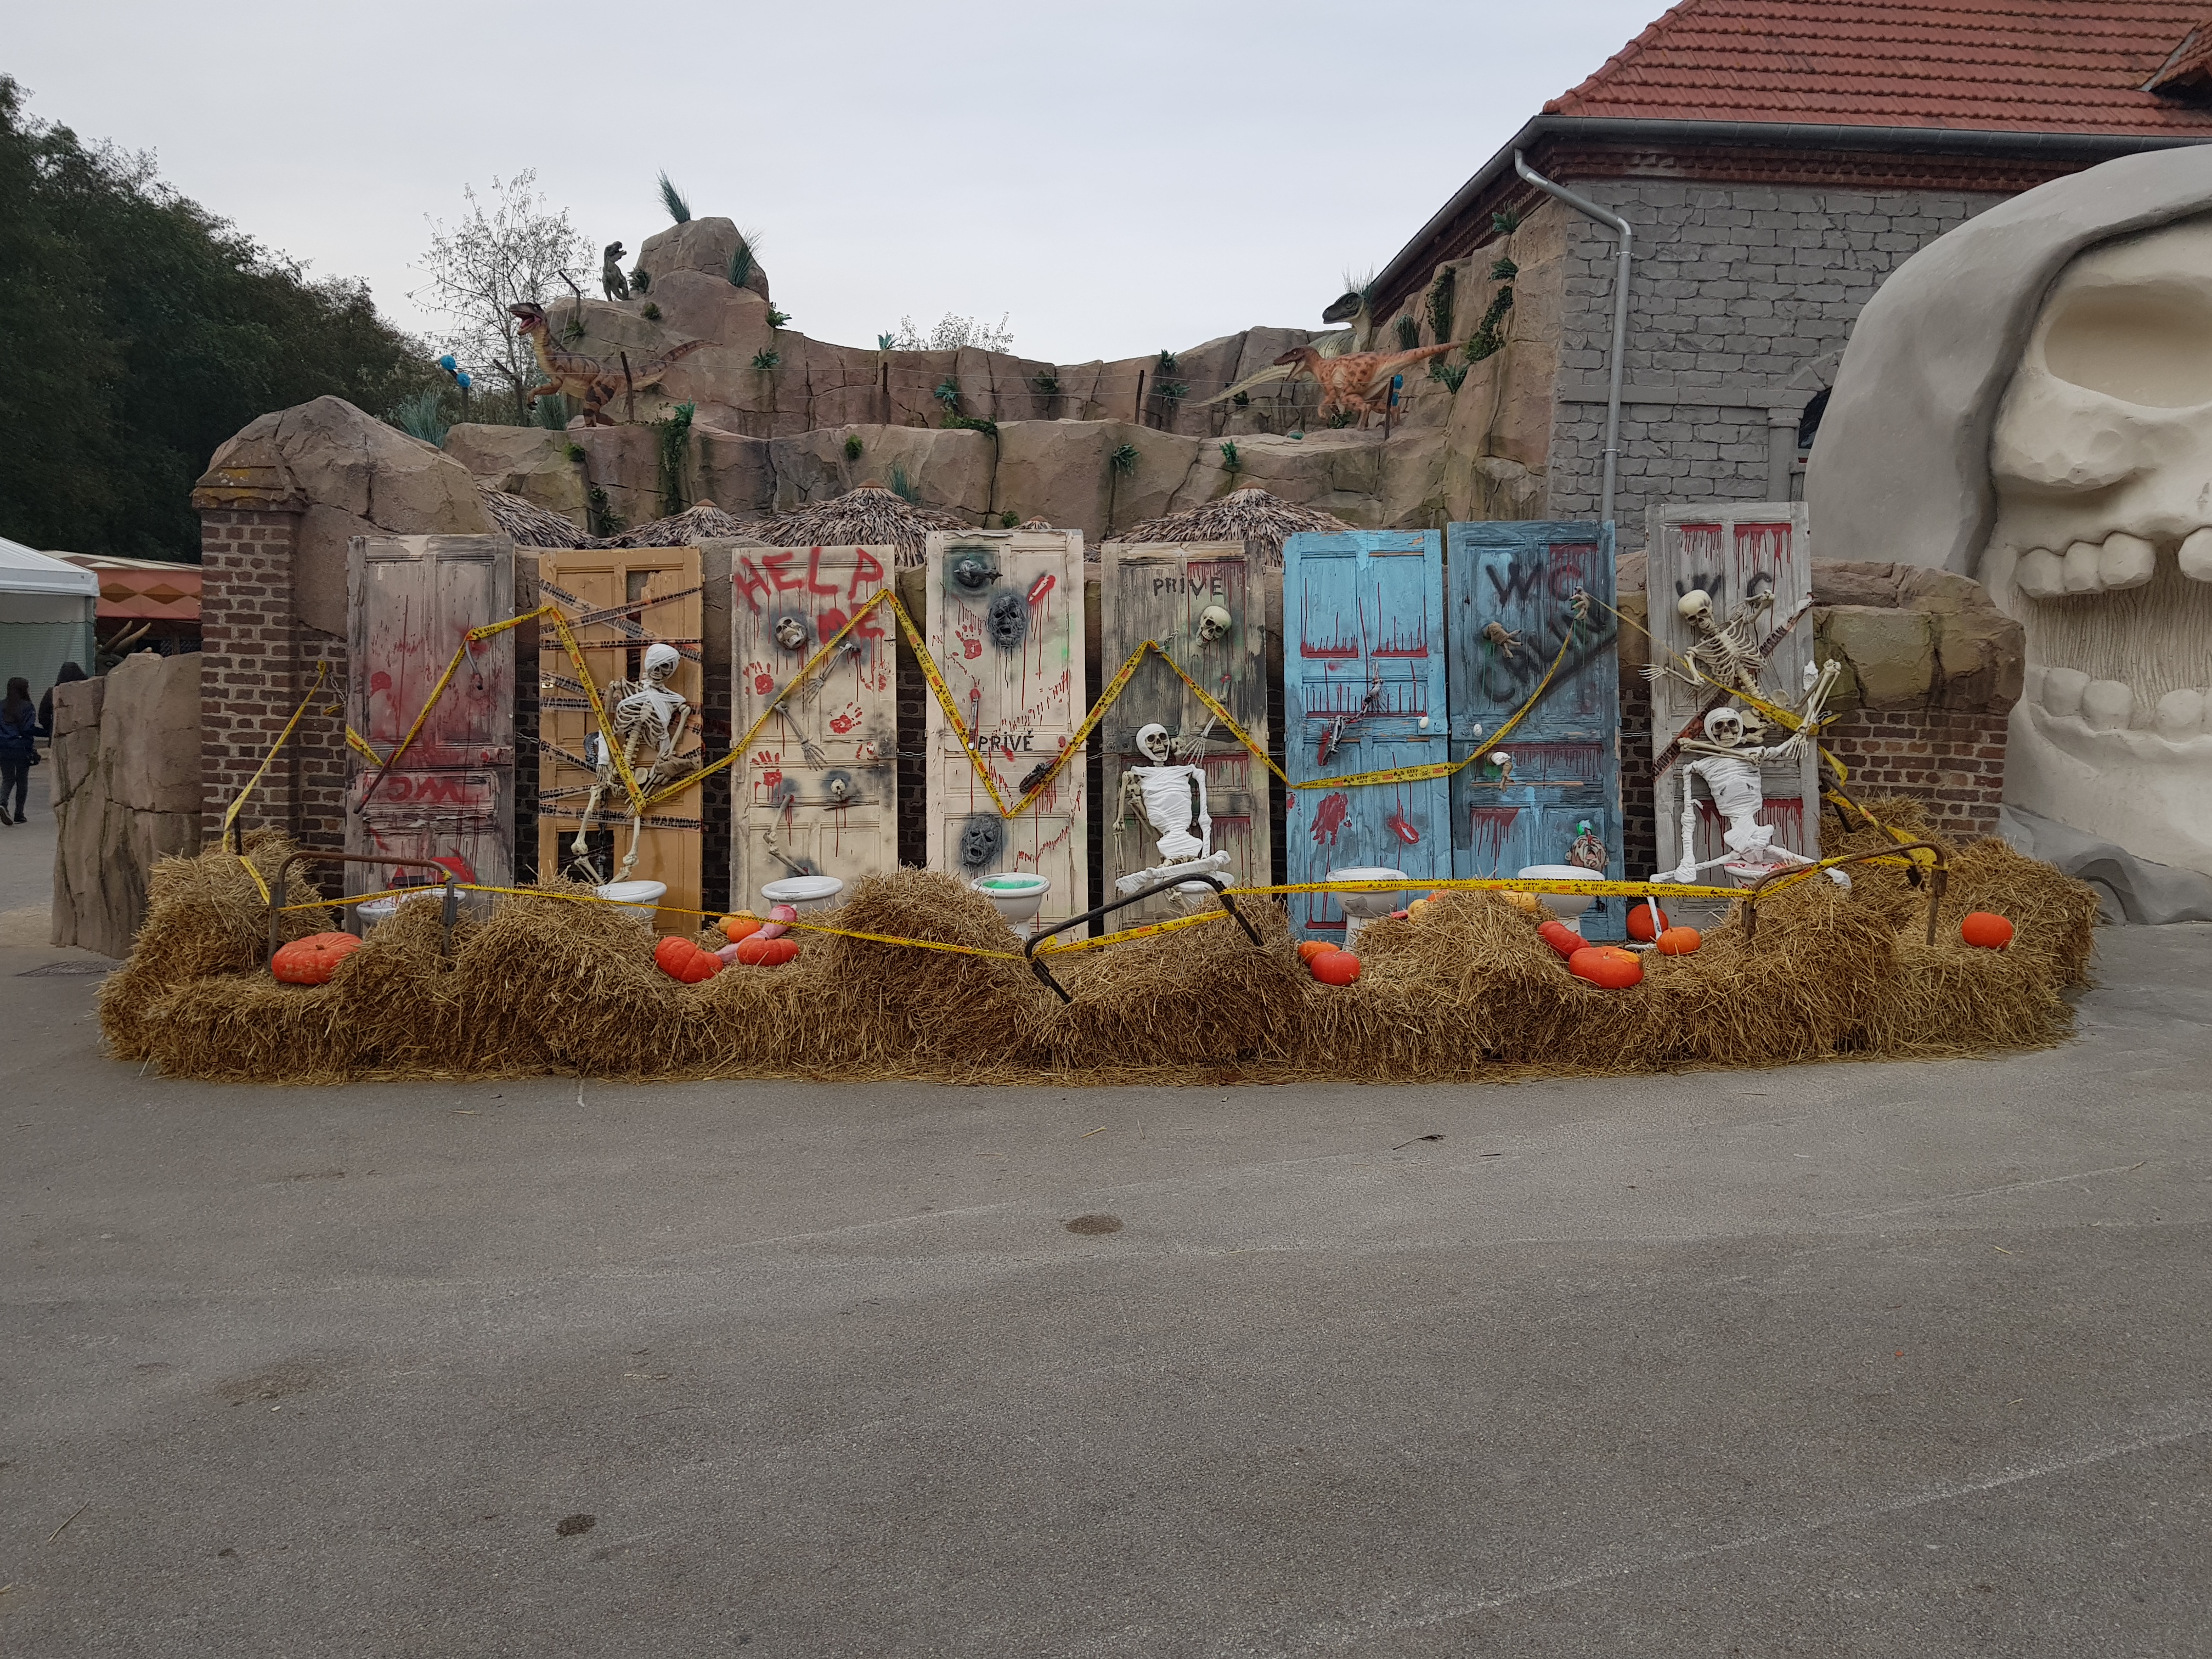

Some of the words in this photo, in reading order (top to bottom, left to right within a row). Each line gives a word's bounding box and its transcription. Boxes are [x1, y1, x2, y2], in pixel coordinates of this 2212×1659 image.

[540, 579, 578, 606] ARNING!
[734, 546, 884, 617] HELP
[1486, 562, 1583, 607] WC
[817, 603, 884, 646] ME
[922, 652, 931, 664] KEEP
[944, 695, 954, 707] KEEP
[1104, 685, 1114, 697] KEEP
